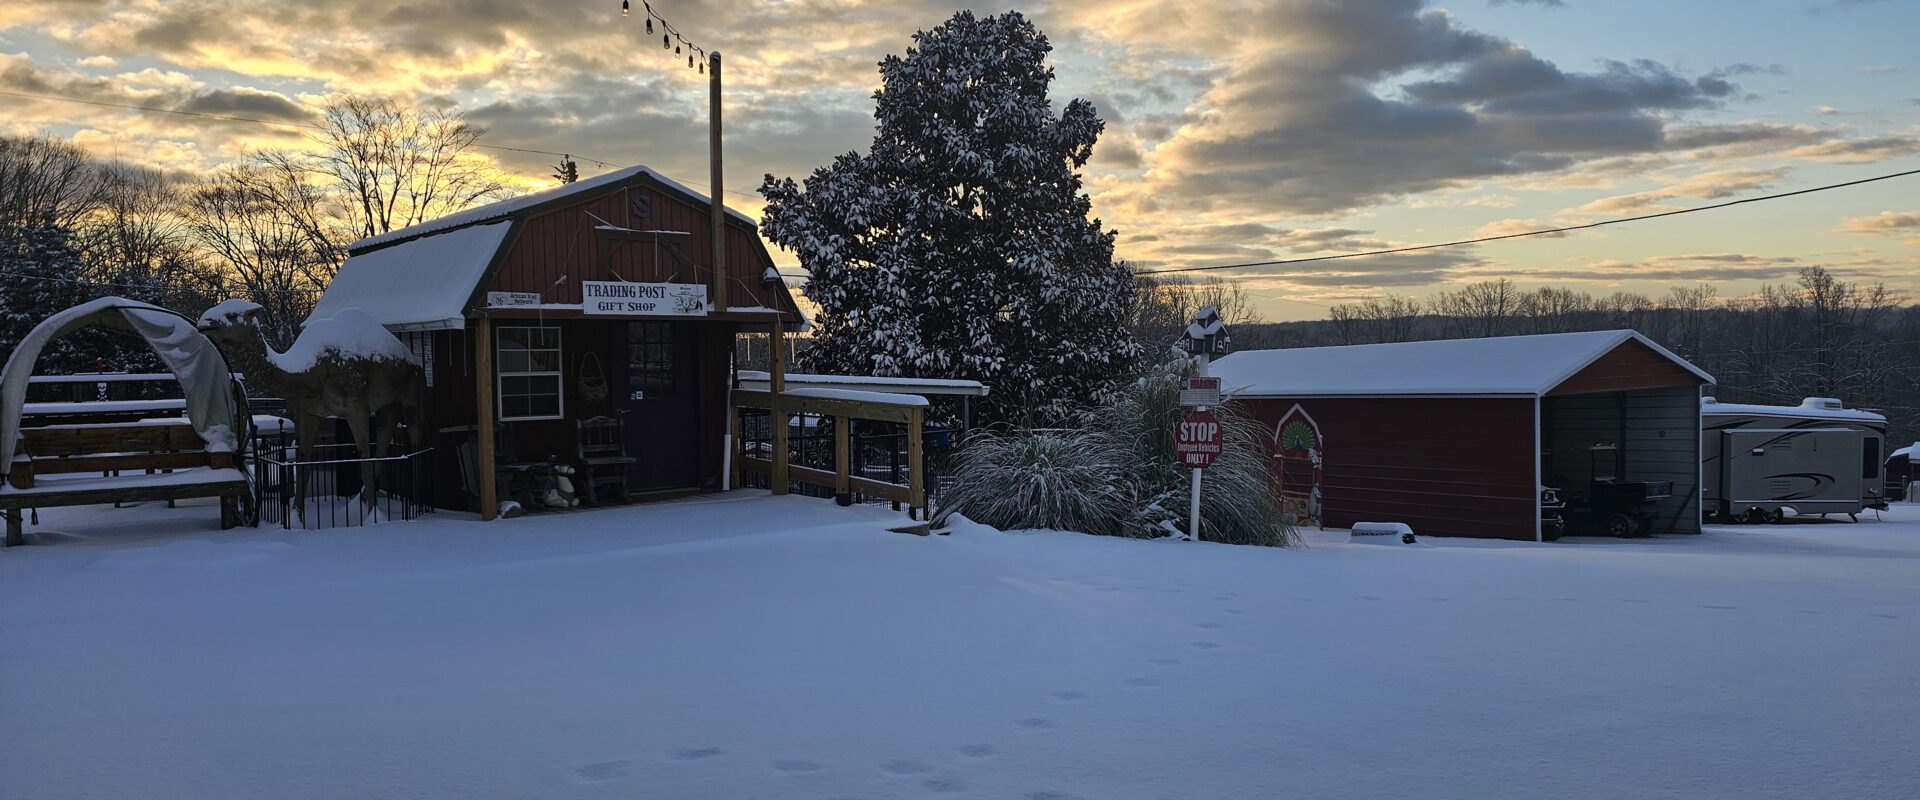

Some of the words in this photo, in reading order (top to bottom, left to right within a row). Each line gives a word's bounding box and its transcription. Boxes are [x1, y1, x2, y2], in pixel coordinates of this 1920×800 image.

[585, 284, 636, 298] TRADING
[639, 285, 666, 299] POST
[598, 301, 624, 311] GIFT
[628, 301, 656, 312] SHOP
[1180, 422, 1218, 442] STOP
[1177, 442, 1198, 453] Employee
[1198, 442, 1220, 453] Vehicles
[1186, 453, 1204, 464] ONLY
